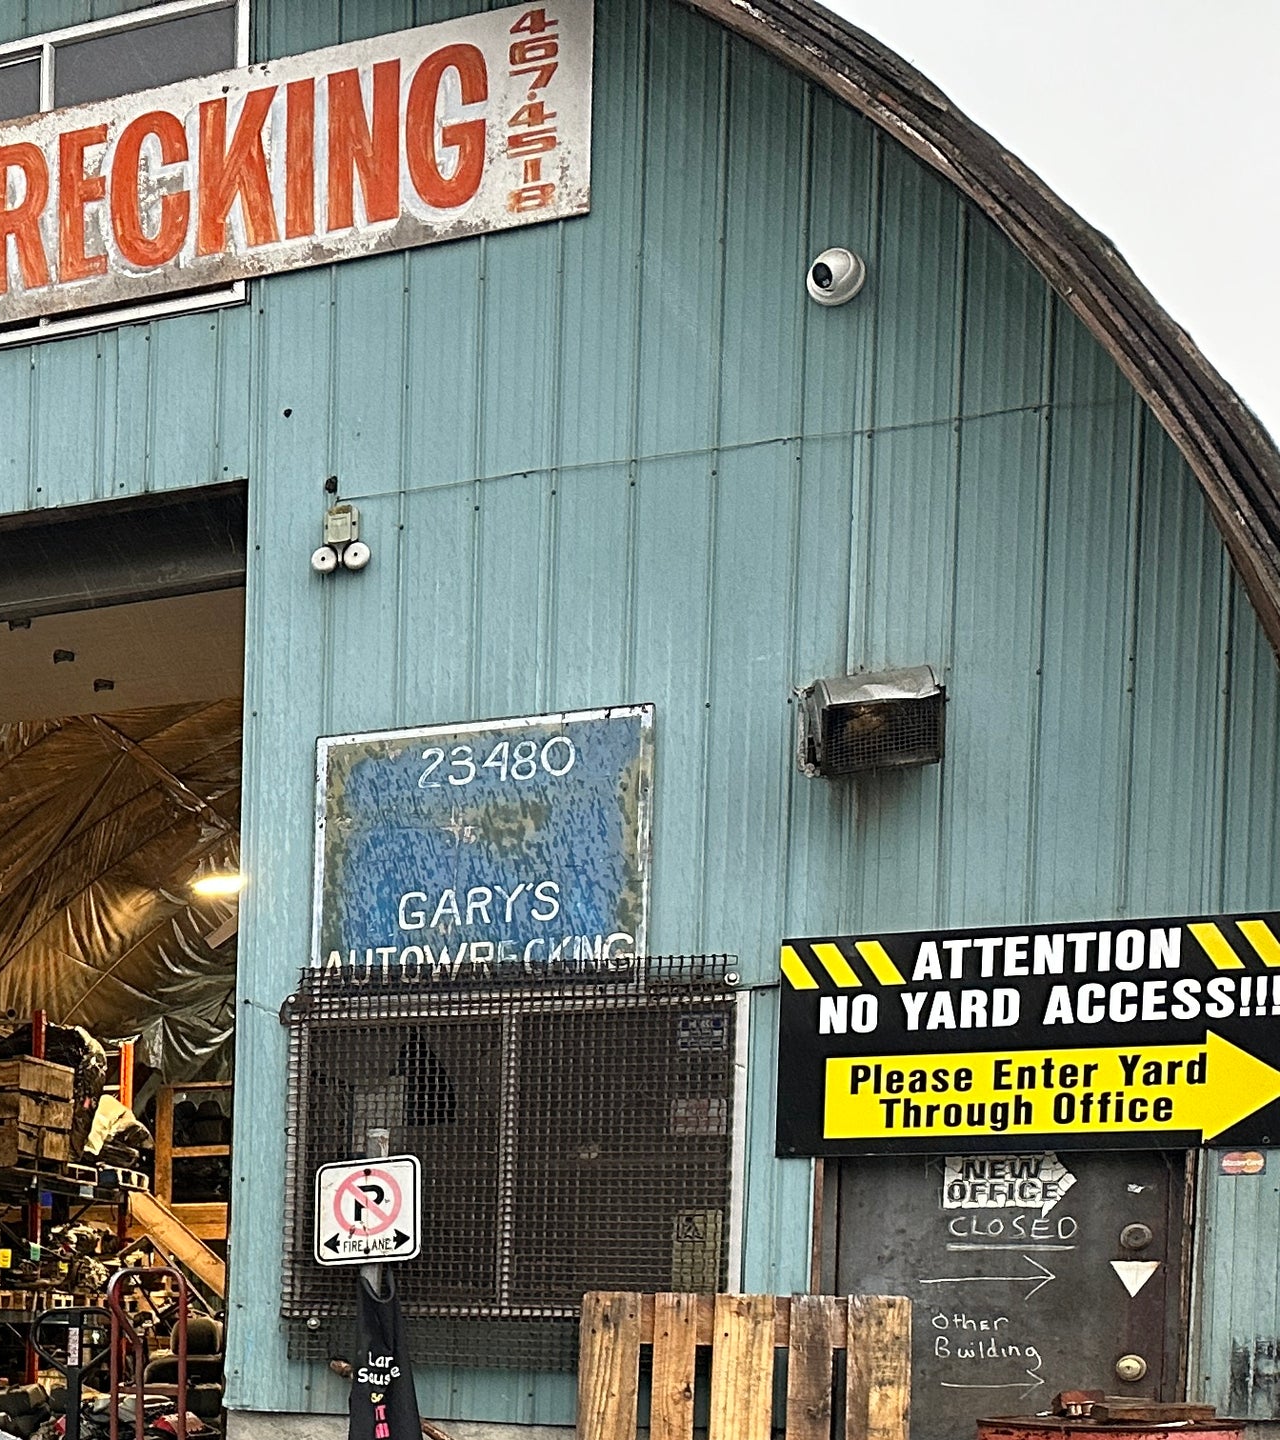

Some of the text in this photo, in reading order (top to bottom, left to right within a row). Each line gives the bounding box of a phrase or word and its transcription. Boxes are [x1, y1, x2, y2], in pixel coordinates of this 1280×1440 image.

[417, 735, 576, 789] 23480
[398, 880, 560, 931] GARY'S
[325, 932, 635, 986] AUTOWRECKING
[912, 926, 1181, 982] ATTENTION
[819, 974, 1280, 1034] NO YARD ACCESS!!!
[850, 1052, 1207, 1095] Please Enter Yard
[879, 1092, 1173, 1132] Through Office
[962, 1159, 1041, 1180] NEW
[947, 1180, 1059, 1201] OFFICE
[343, 1240, 363, 1253] FIRE
[949, 1215, 1078, 1239] CLOSED
[934, 1336, 1043, 1372] Building
